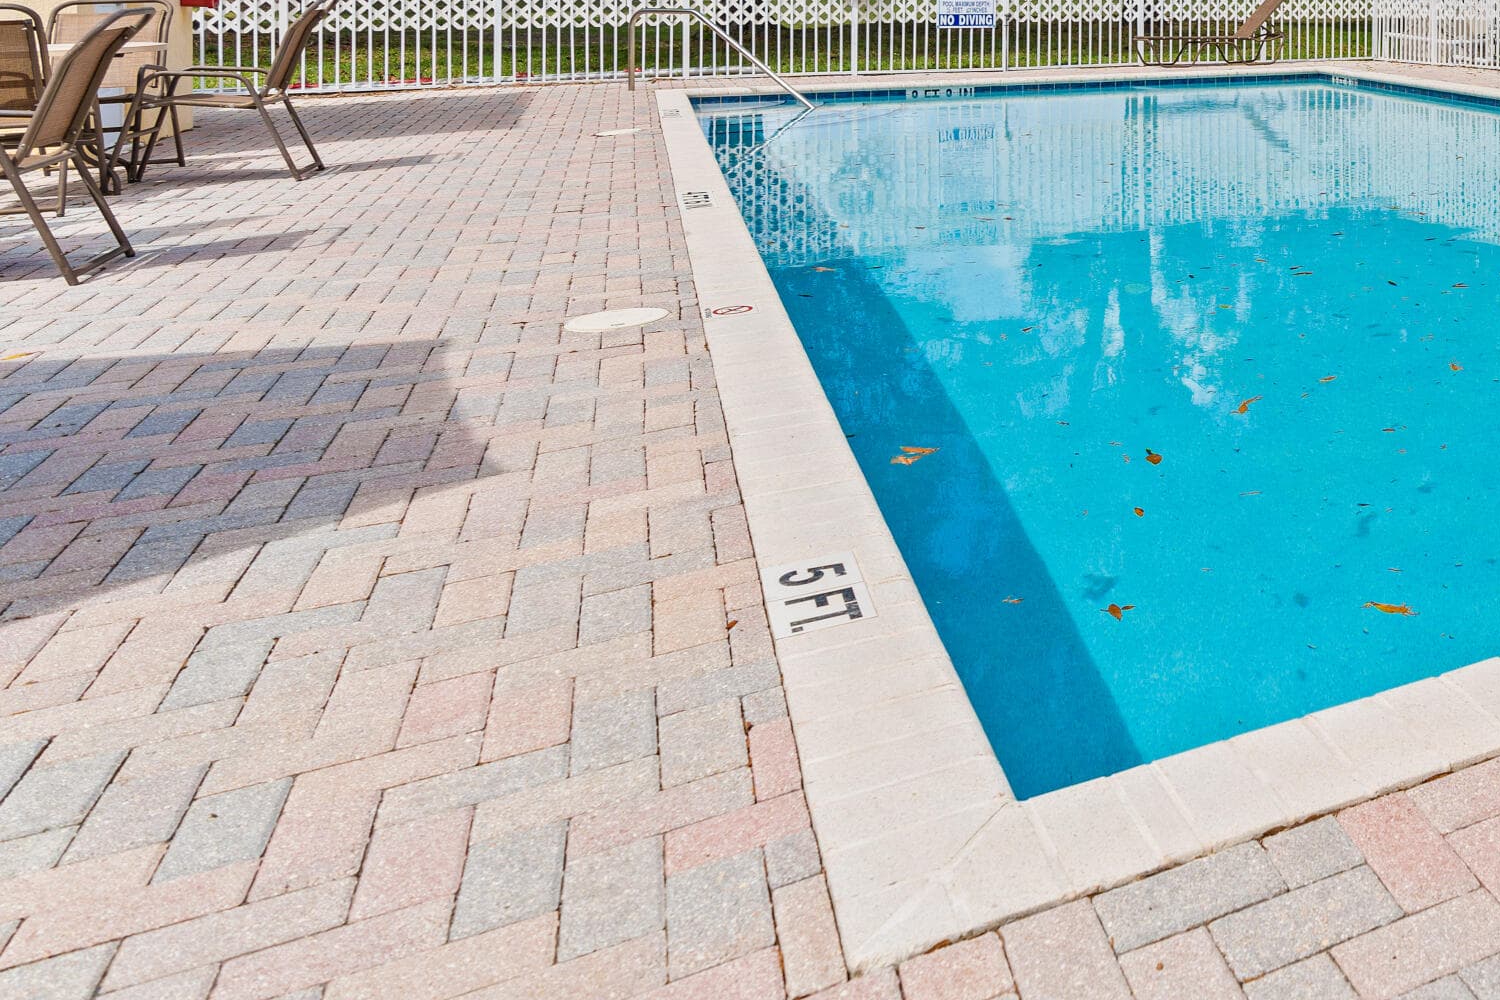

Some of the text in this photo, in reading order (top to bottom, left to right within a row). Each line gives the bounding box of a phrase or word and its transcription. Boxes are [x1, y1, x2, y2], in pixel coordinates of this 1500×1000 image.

[940, 15, 993, 26] NO DIVING
[779, 562, 847, 587] 5
